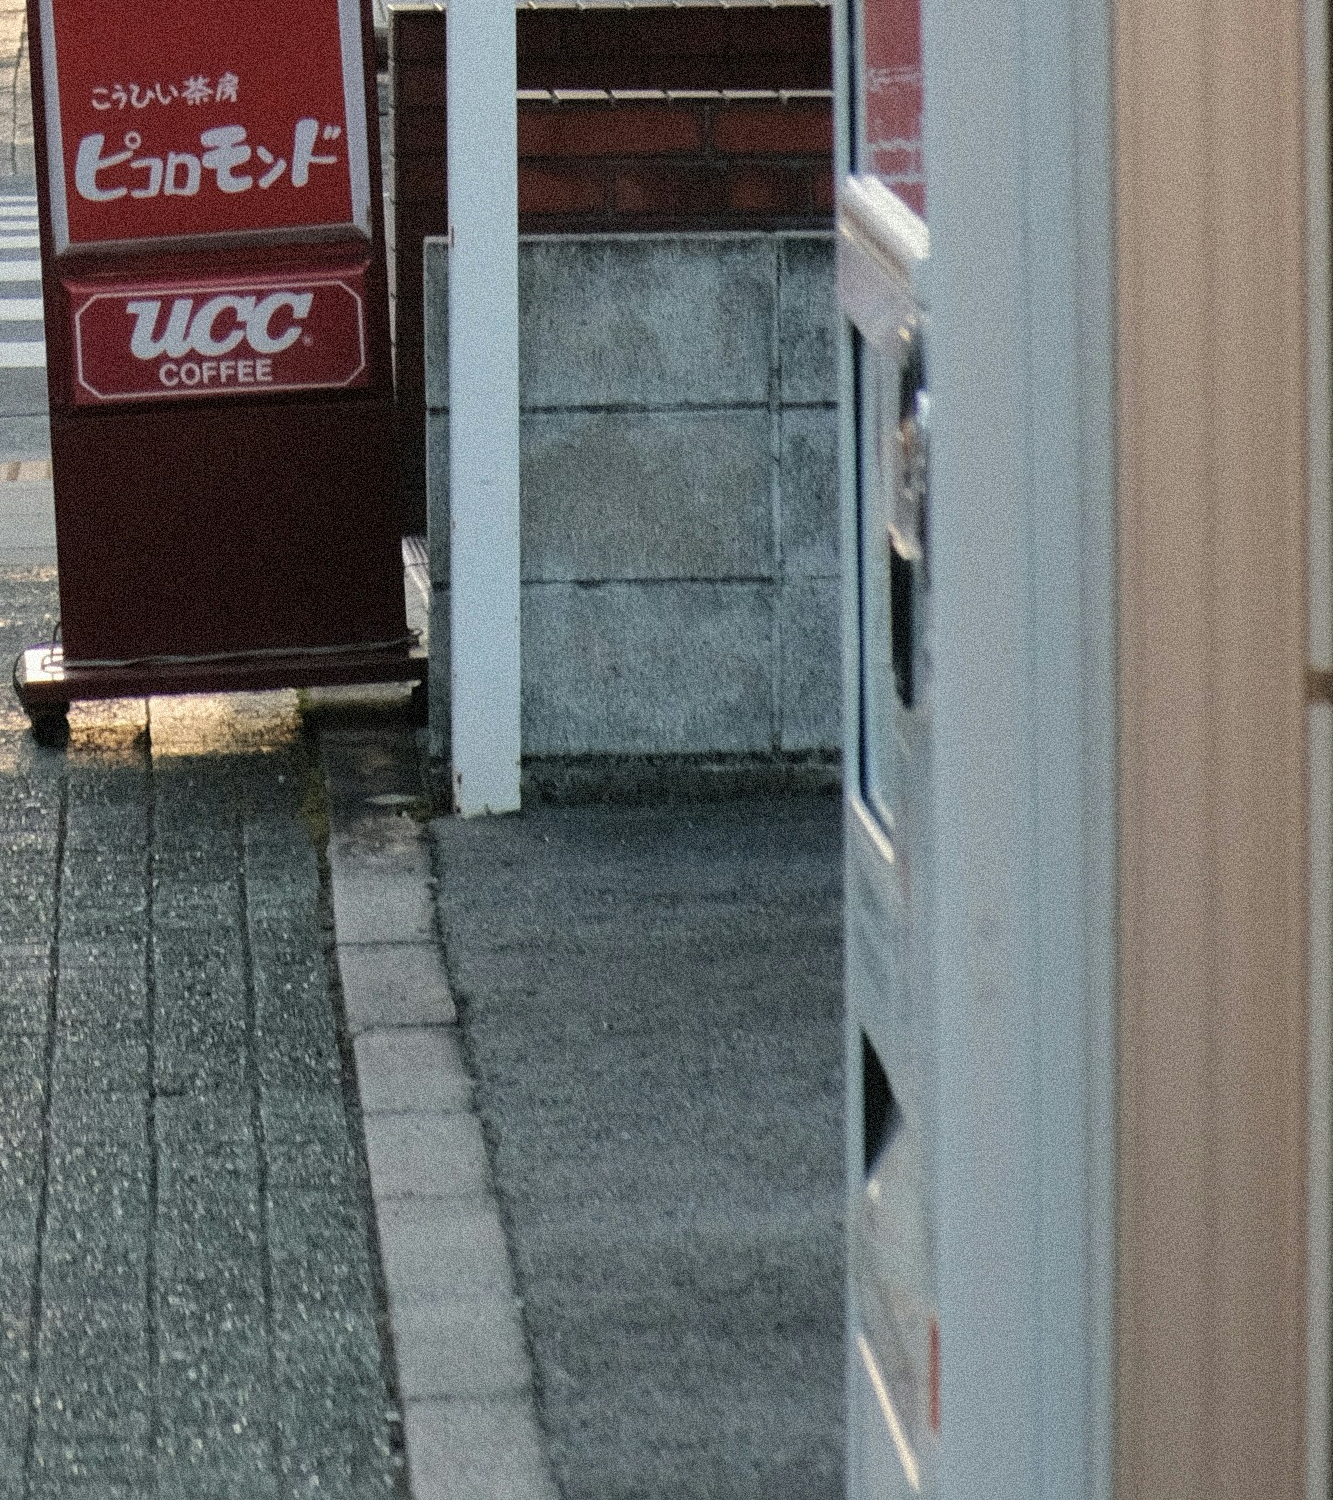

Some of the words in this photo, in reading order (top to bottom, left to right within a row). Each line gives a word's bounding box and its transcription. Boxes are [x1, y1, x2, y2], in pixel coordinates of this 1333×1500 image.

[90, 71, 241, 111] こうひい茶房
[75, 117, 342, 202] ピコロモンド
[158, 360, 273, 387] COFFEE
